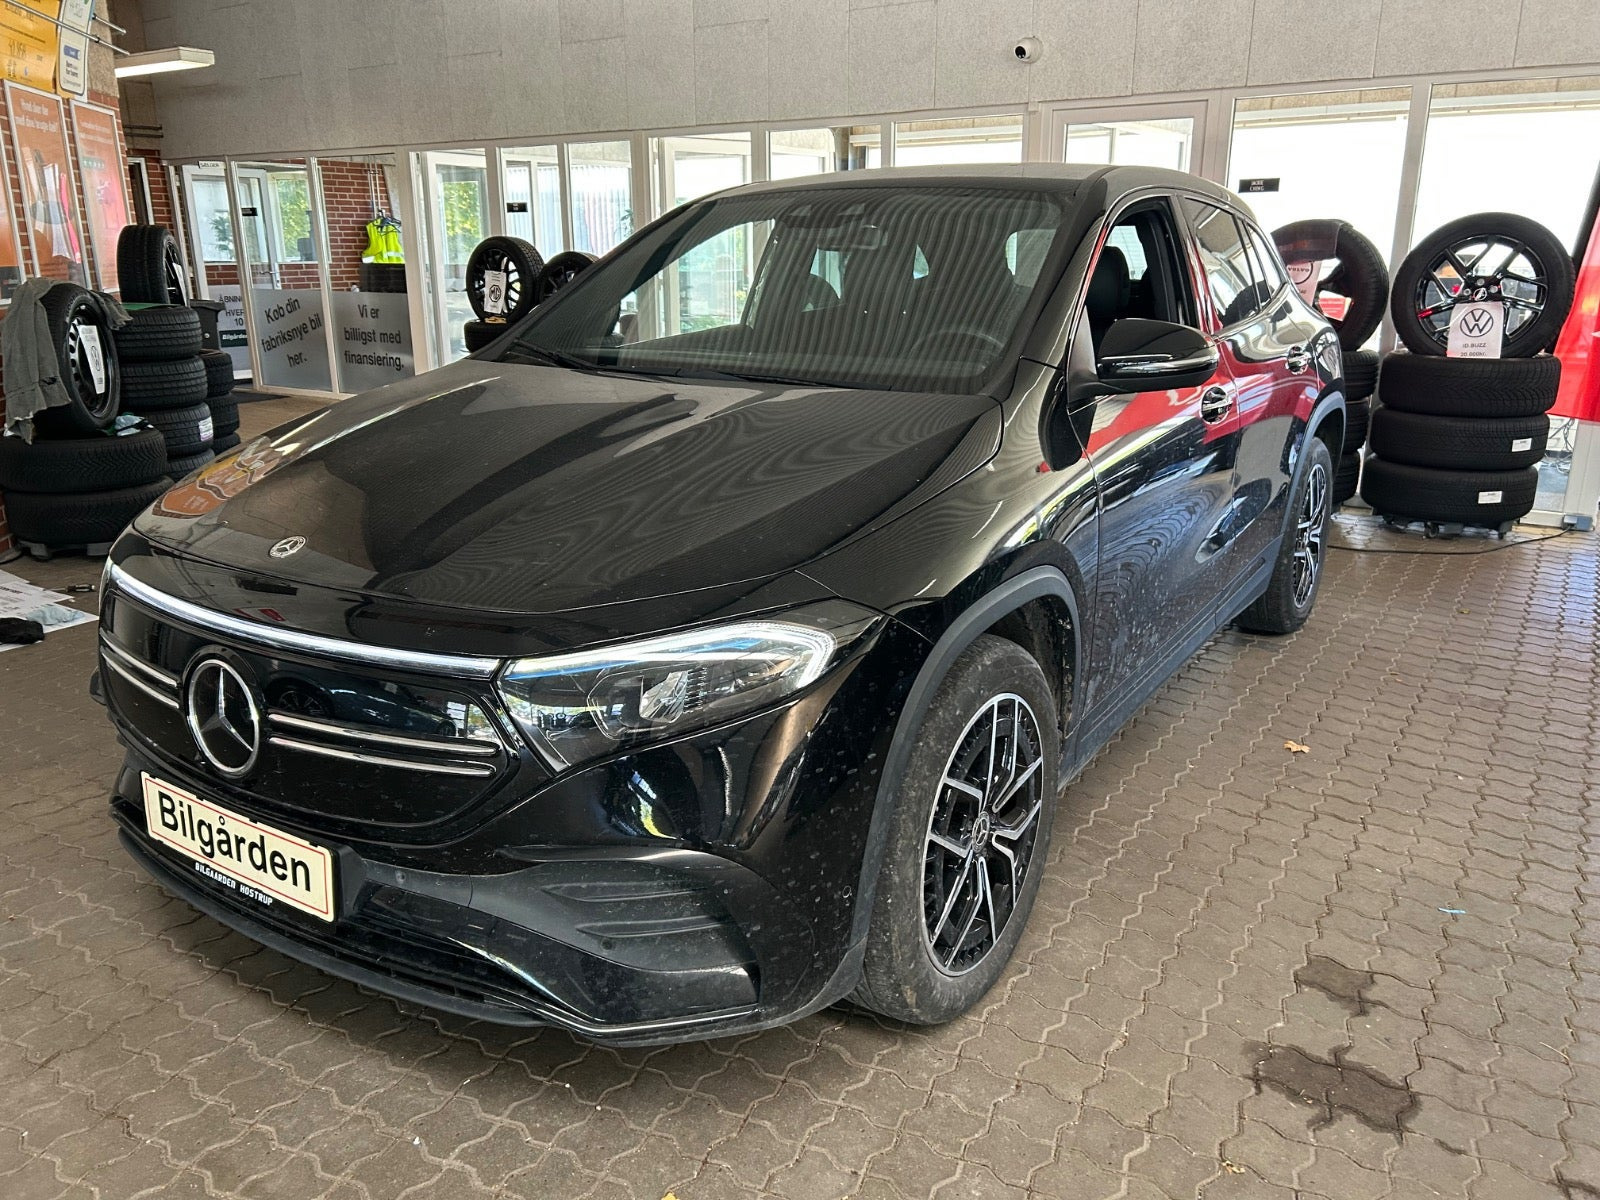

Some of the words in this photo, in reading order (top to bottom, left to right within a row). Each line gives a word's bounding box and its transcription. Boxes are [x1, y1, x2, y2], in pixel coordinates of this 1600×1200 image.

[286, 297, 301, 314] din
[357, 304, 368, 318] Vi
[370, 308, 380, 319] er
[261, 323, 309, 353] fabriksnye
[308, 312, 322, 330] bil
[344, 327, 376, 345] billigst
[379, 330, 402, 344] med
[286, 352, 308, 367] her.
[344, 350, 404, 371] finansiering.
[158, 790, 311, 893] Bilgården
[195, 862, 236, 889] BILGAARDEN
[240, 884, 273, 906] HOSTRUP
